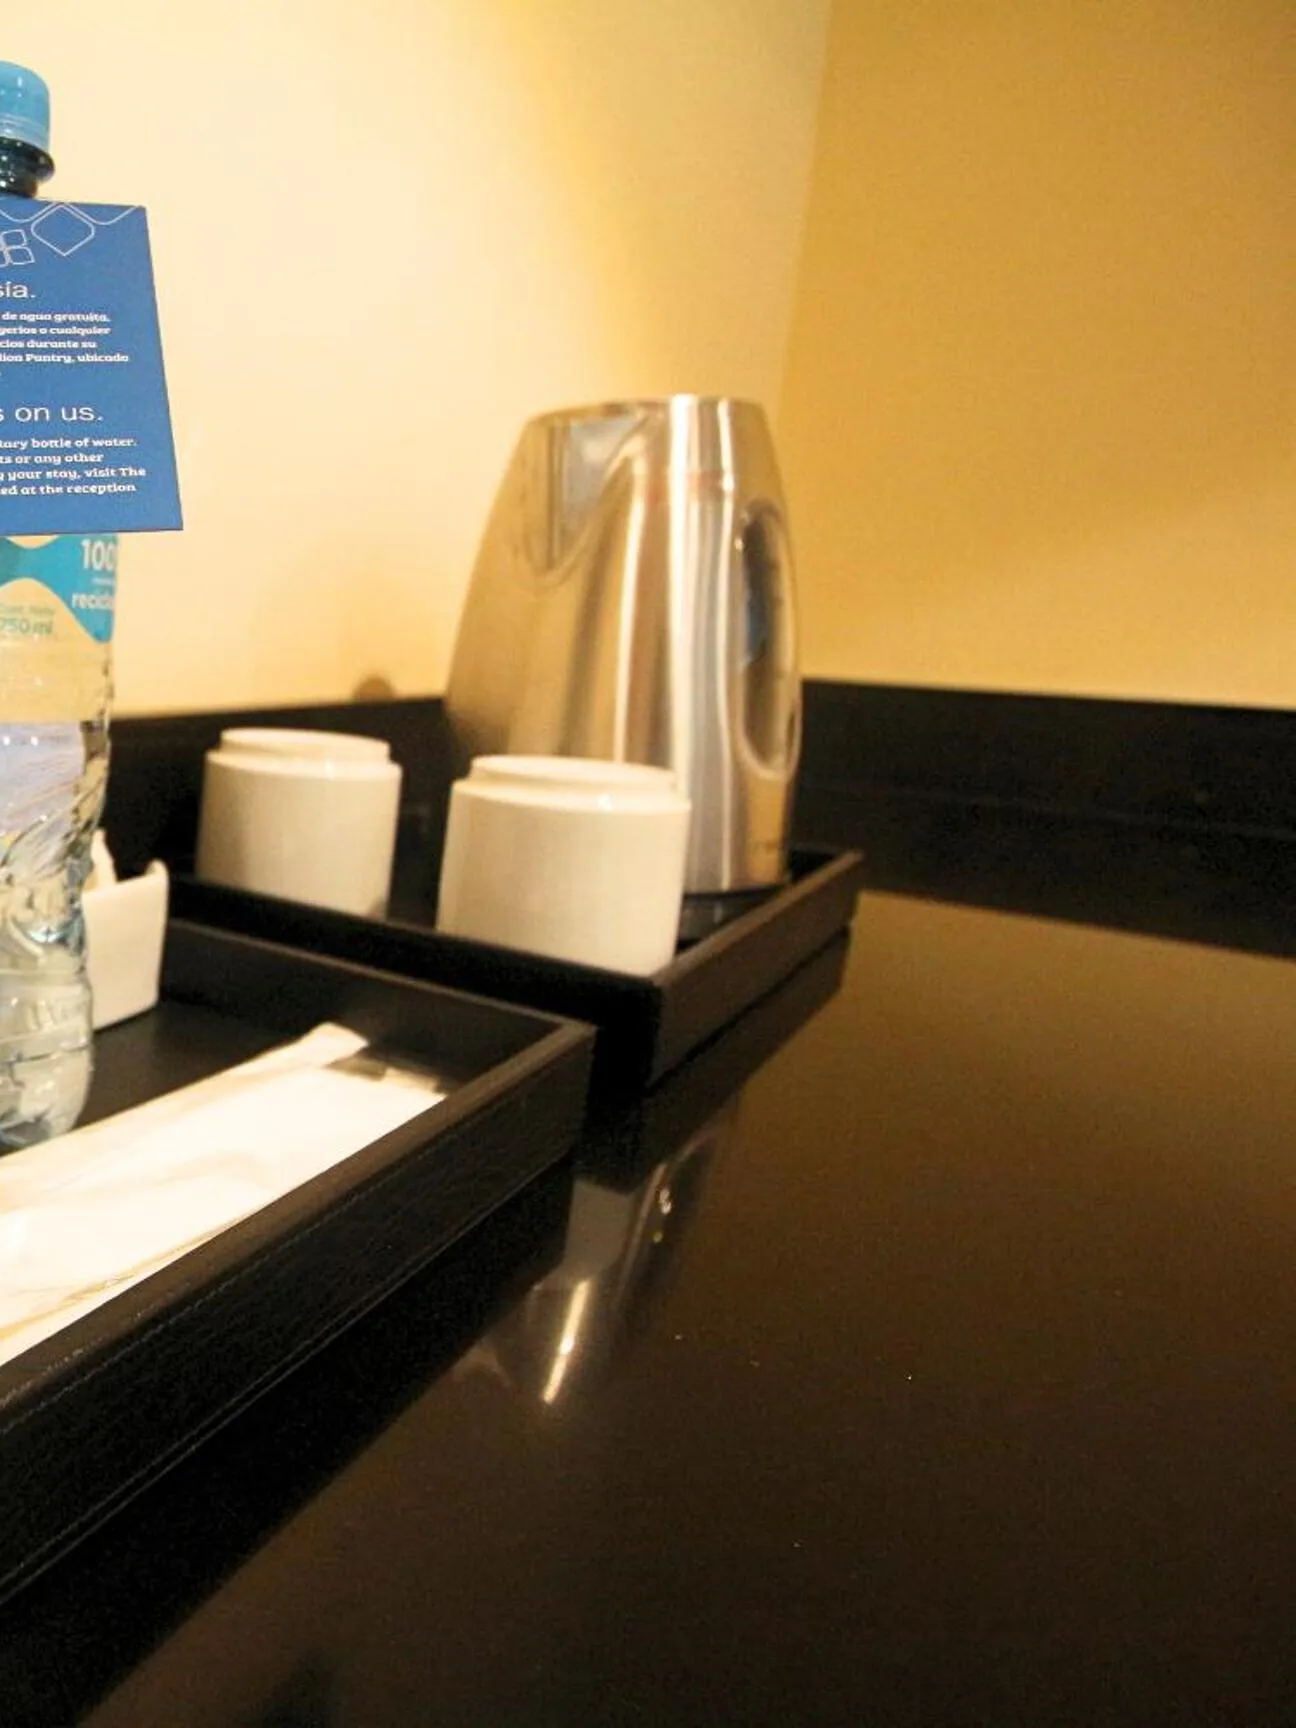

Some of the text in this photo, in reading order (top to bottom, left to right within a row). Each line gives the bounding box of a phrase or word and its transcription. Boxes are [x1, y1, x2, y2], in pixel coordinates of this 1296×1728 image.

[1, 311, 18, 320] de
[19, 313, 52, 323] agua
[49, 326, 111, 337] cualquier
[26, 339, 79, 349] durante
[76, 352, 129, 363] ubicado
[14, 407, 51, 422] on
[60, 406, 104, 422] us.
[31, 437, 72, 448] bottle
[74, 437, 90, 448] of
[14, 455, 31, 464] or
[33, 455, 62, 465] any
[64, 453, 104, 462] other
[7, 471, 42, 482] your
[45, 469, 82, 481] stay,
[83, 467, 117, 478] visit
[117, 466, 146, 477] The
[20, 486, 37, 495] at
[38, 484, 64, 495] the
[66, 482, 136, 495] reception
